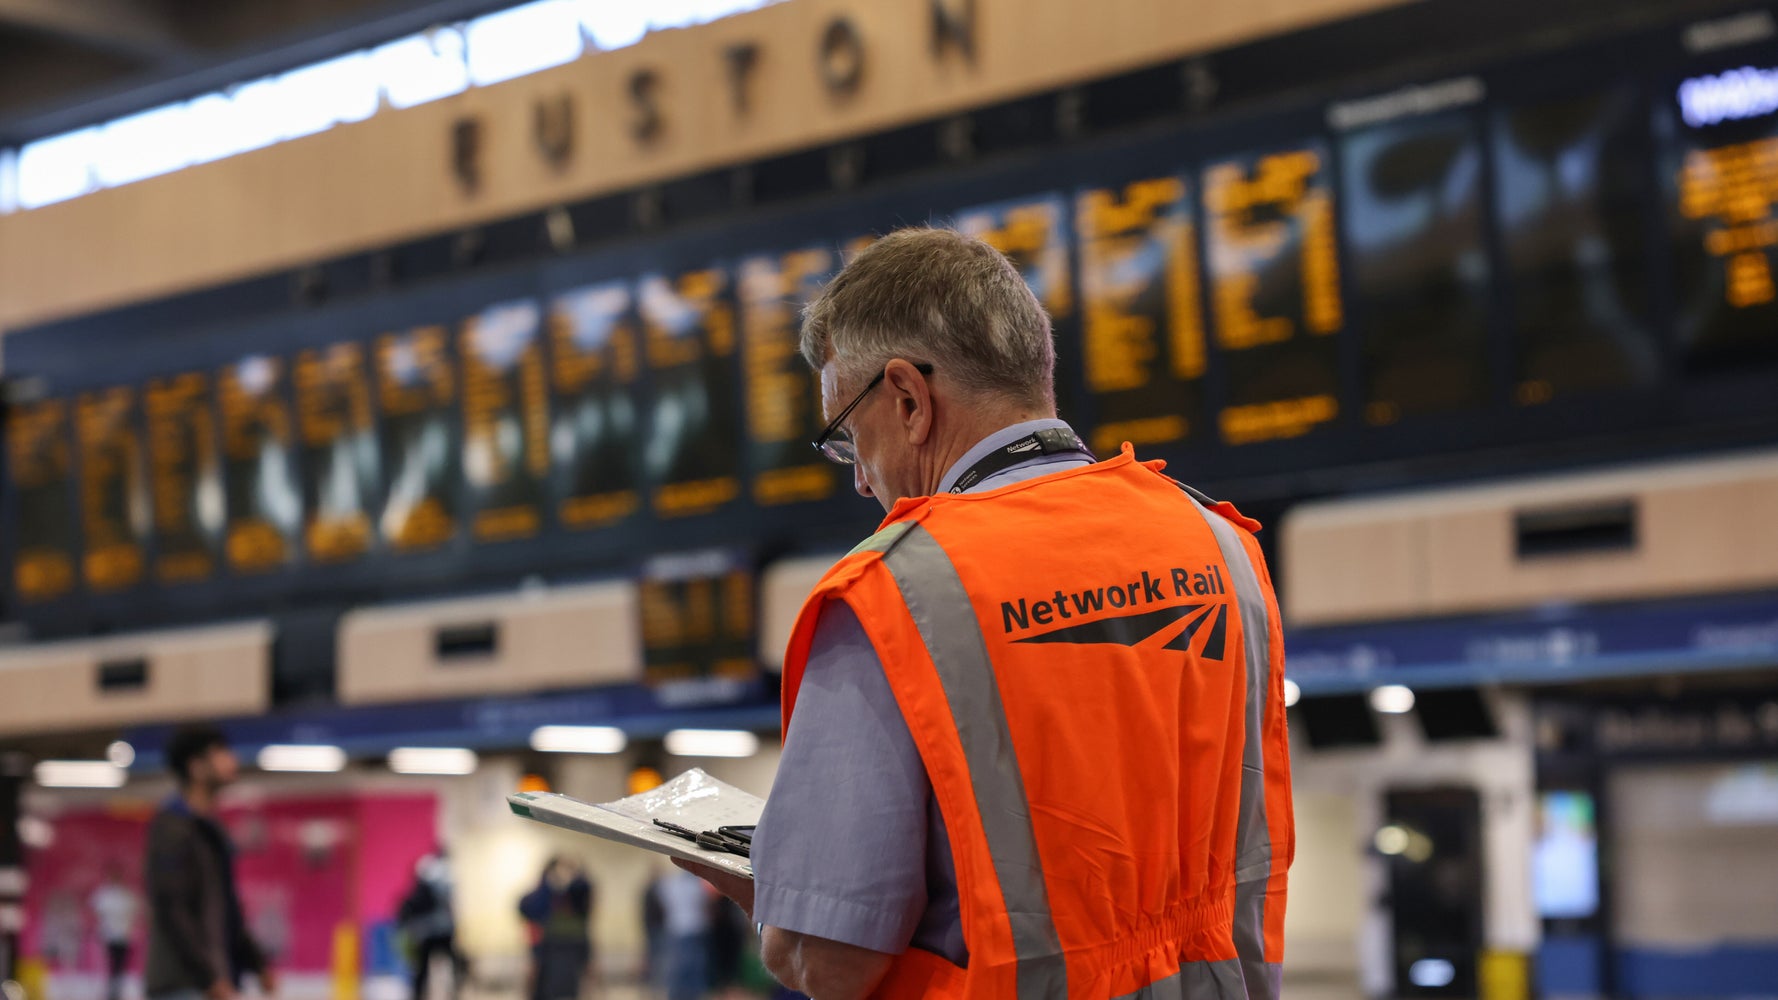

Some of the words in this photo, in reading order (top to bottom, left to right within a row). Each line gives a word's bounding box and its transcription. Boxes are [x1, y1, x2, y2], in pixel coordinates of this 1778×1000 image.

[451, 0, 979, 194] EUSTON
[1006, 437, 1036, 453] Network
[1001, 571, 1165, 633] Network
[1171, 565, 1225, 597] Rail
